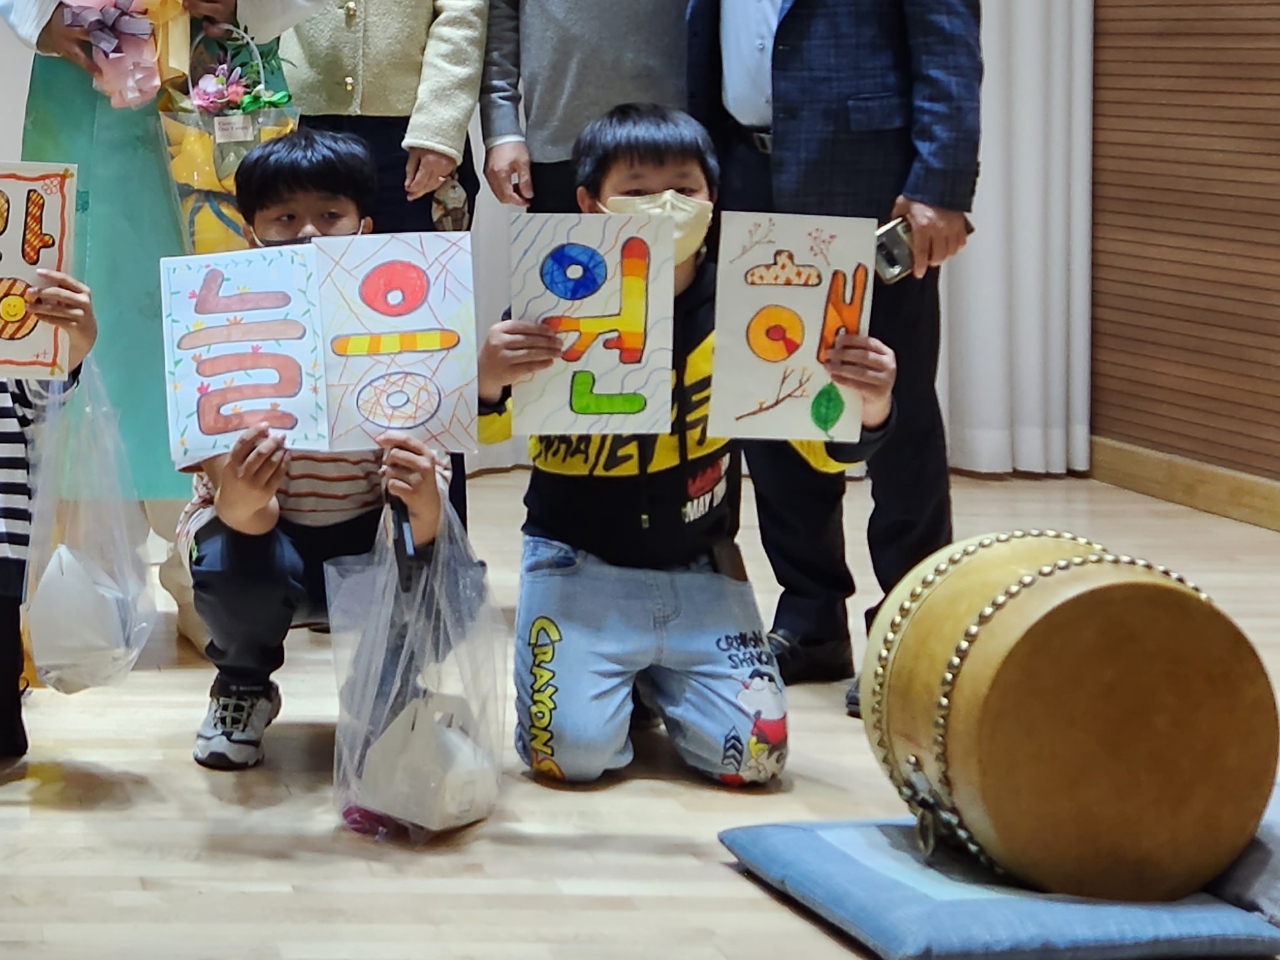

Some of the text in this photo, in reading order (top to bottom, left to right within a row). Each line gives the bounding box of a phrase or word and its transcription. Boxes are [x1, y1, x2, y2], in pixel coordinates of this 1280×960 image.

[177, 268, 306, 436] 늘
[330, 258, 461, 430] 응
[540, 235, 650, 415] 원
[528, 615, 563, 757] CRAYON
